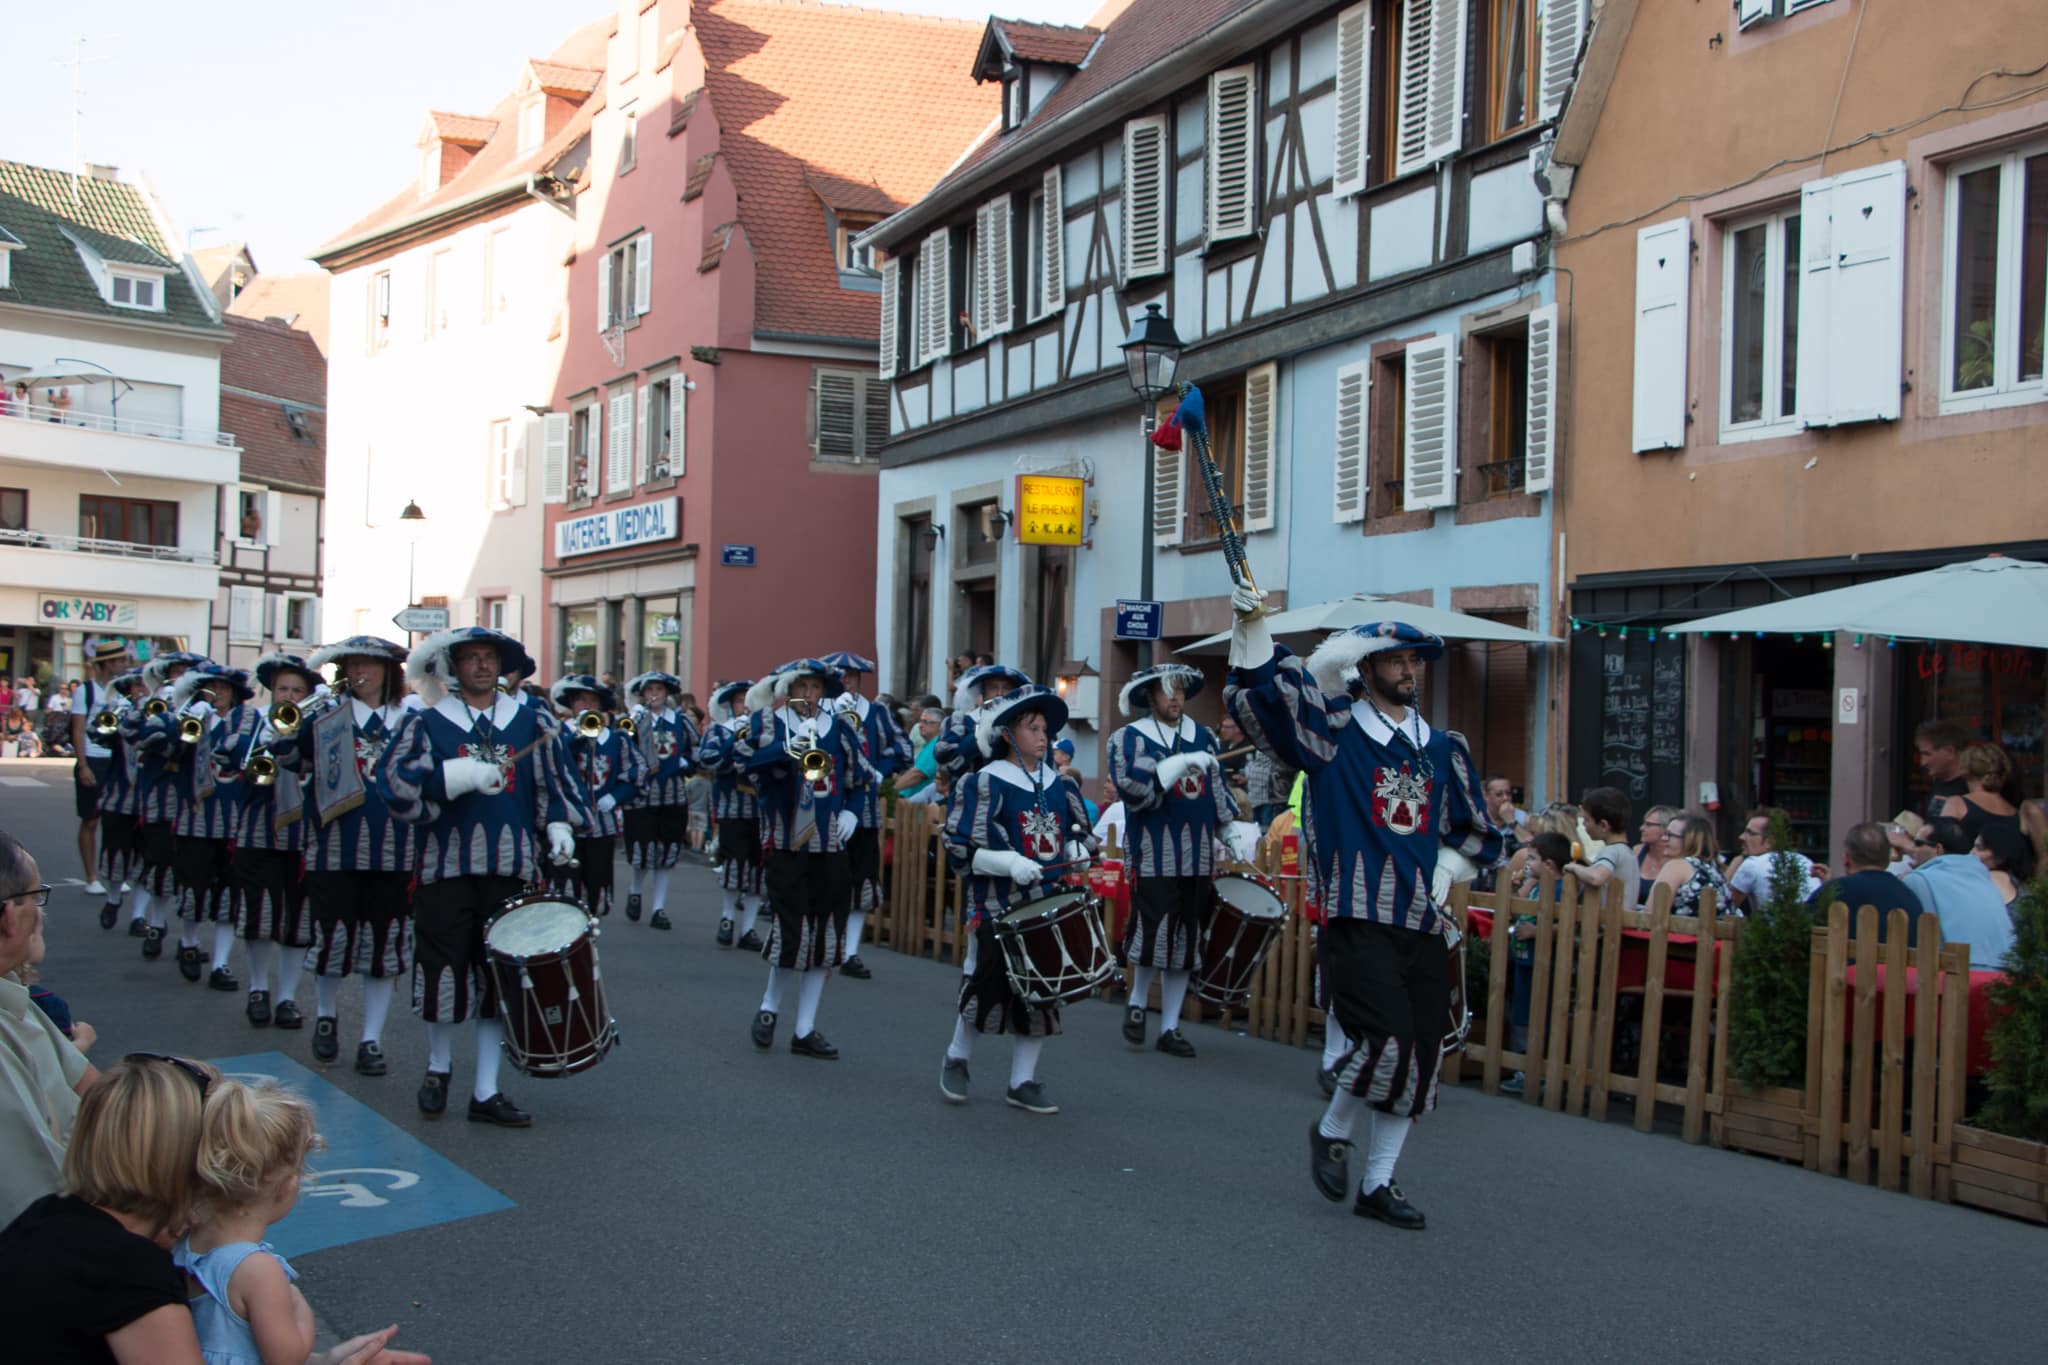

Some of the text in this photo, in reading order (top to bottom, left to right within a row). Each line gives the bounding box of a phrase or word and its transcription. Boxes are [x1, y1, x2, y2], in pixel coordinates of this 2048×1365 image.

[1023, 482, 1081, 497] RESTAURANT
[1026, 503, 1039, 515] LE
[562, 503, 666, 552] MATERIEL MEDICAL
[1126, 621, 1149, 630] CHOUX
